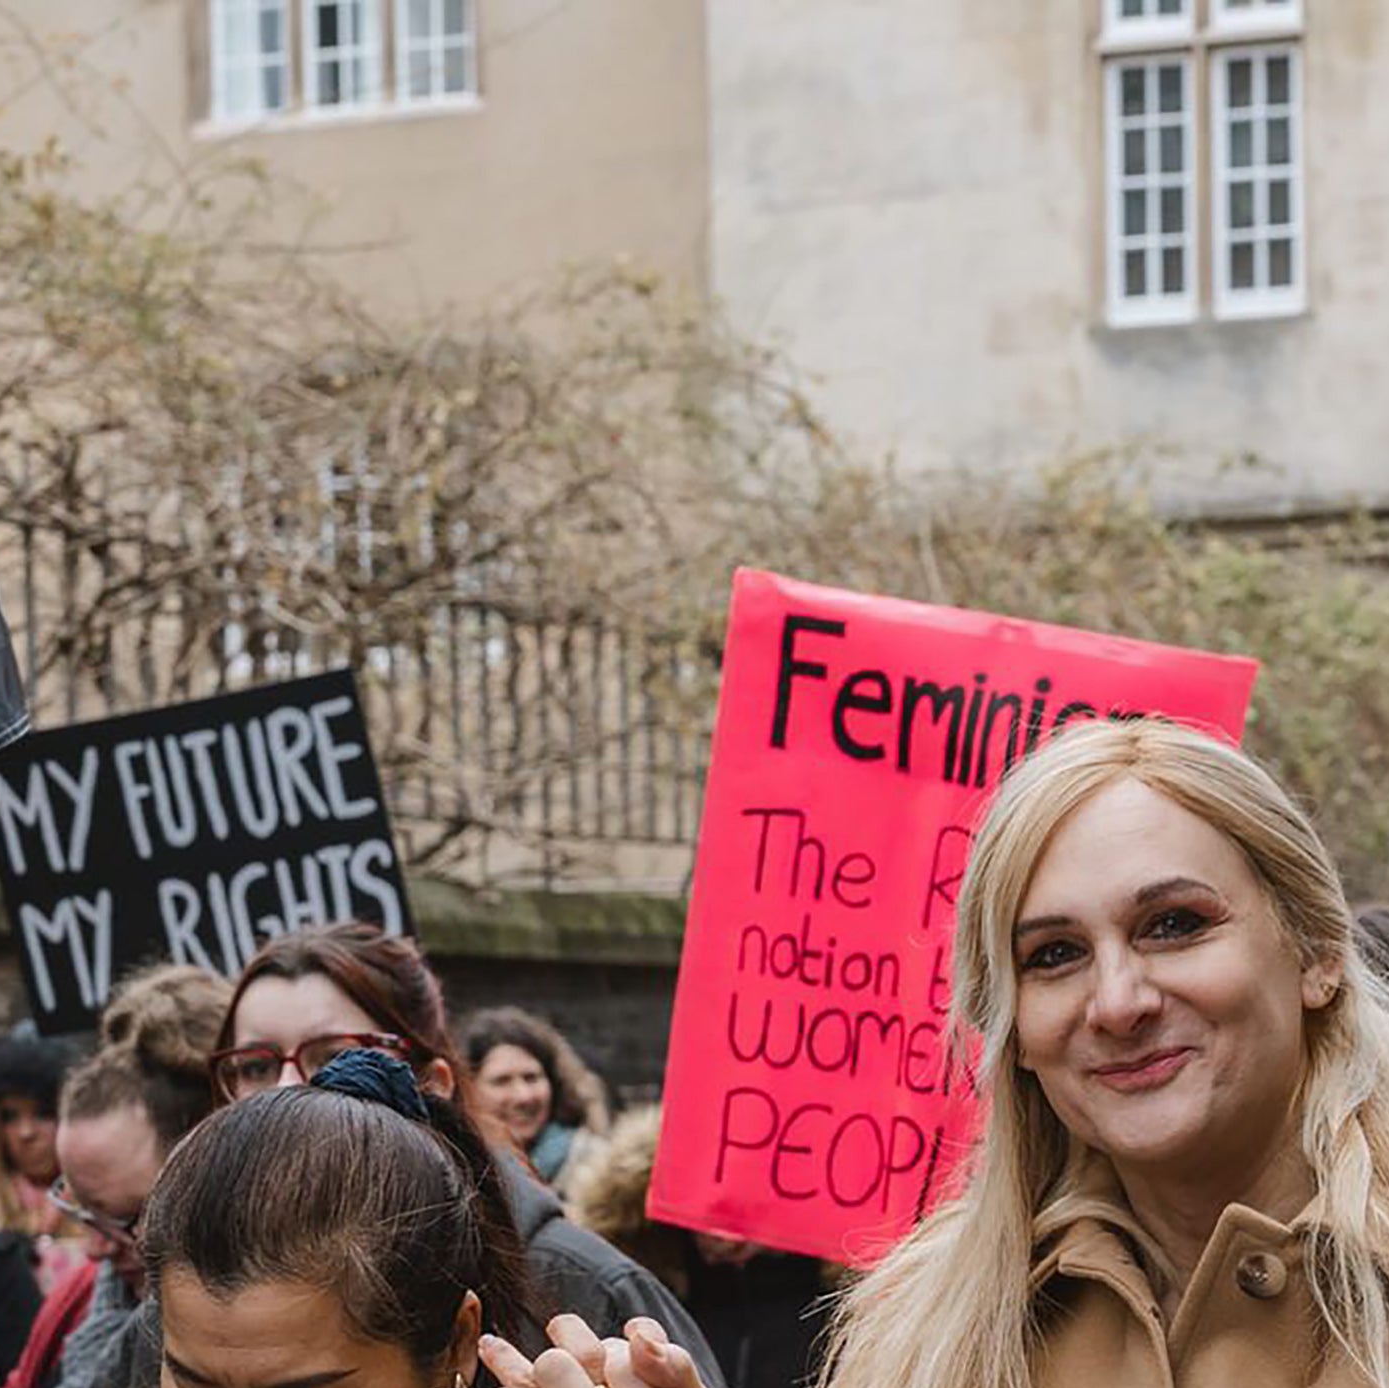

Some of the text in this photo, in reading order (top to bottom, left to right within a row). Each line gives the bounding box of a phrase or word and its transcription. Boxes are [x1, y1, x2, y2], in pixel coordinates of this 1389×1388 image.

[114, 696, 377, 859] FUTURE
[769, 613, 1175, 788] Femini
[19, 838, 404, 1011] MY RIGHTS
[742, 807, 876, 909] The
[738, 912, 900, 998] notion
